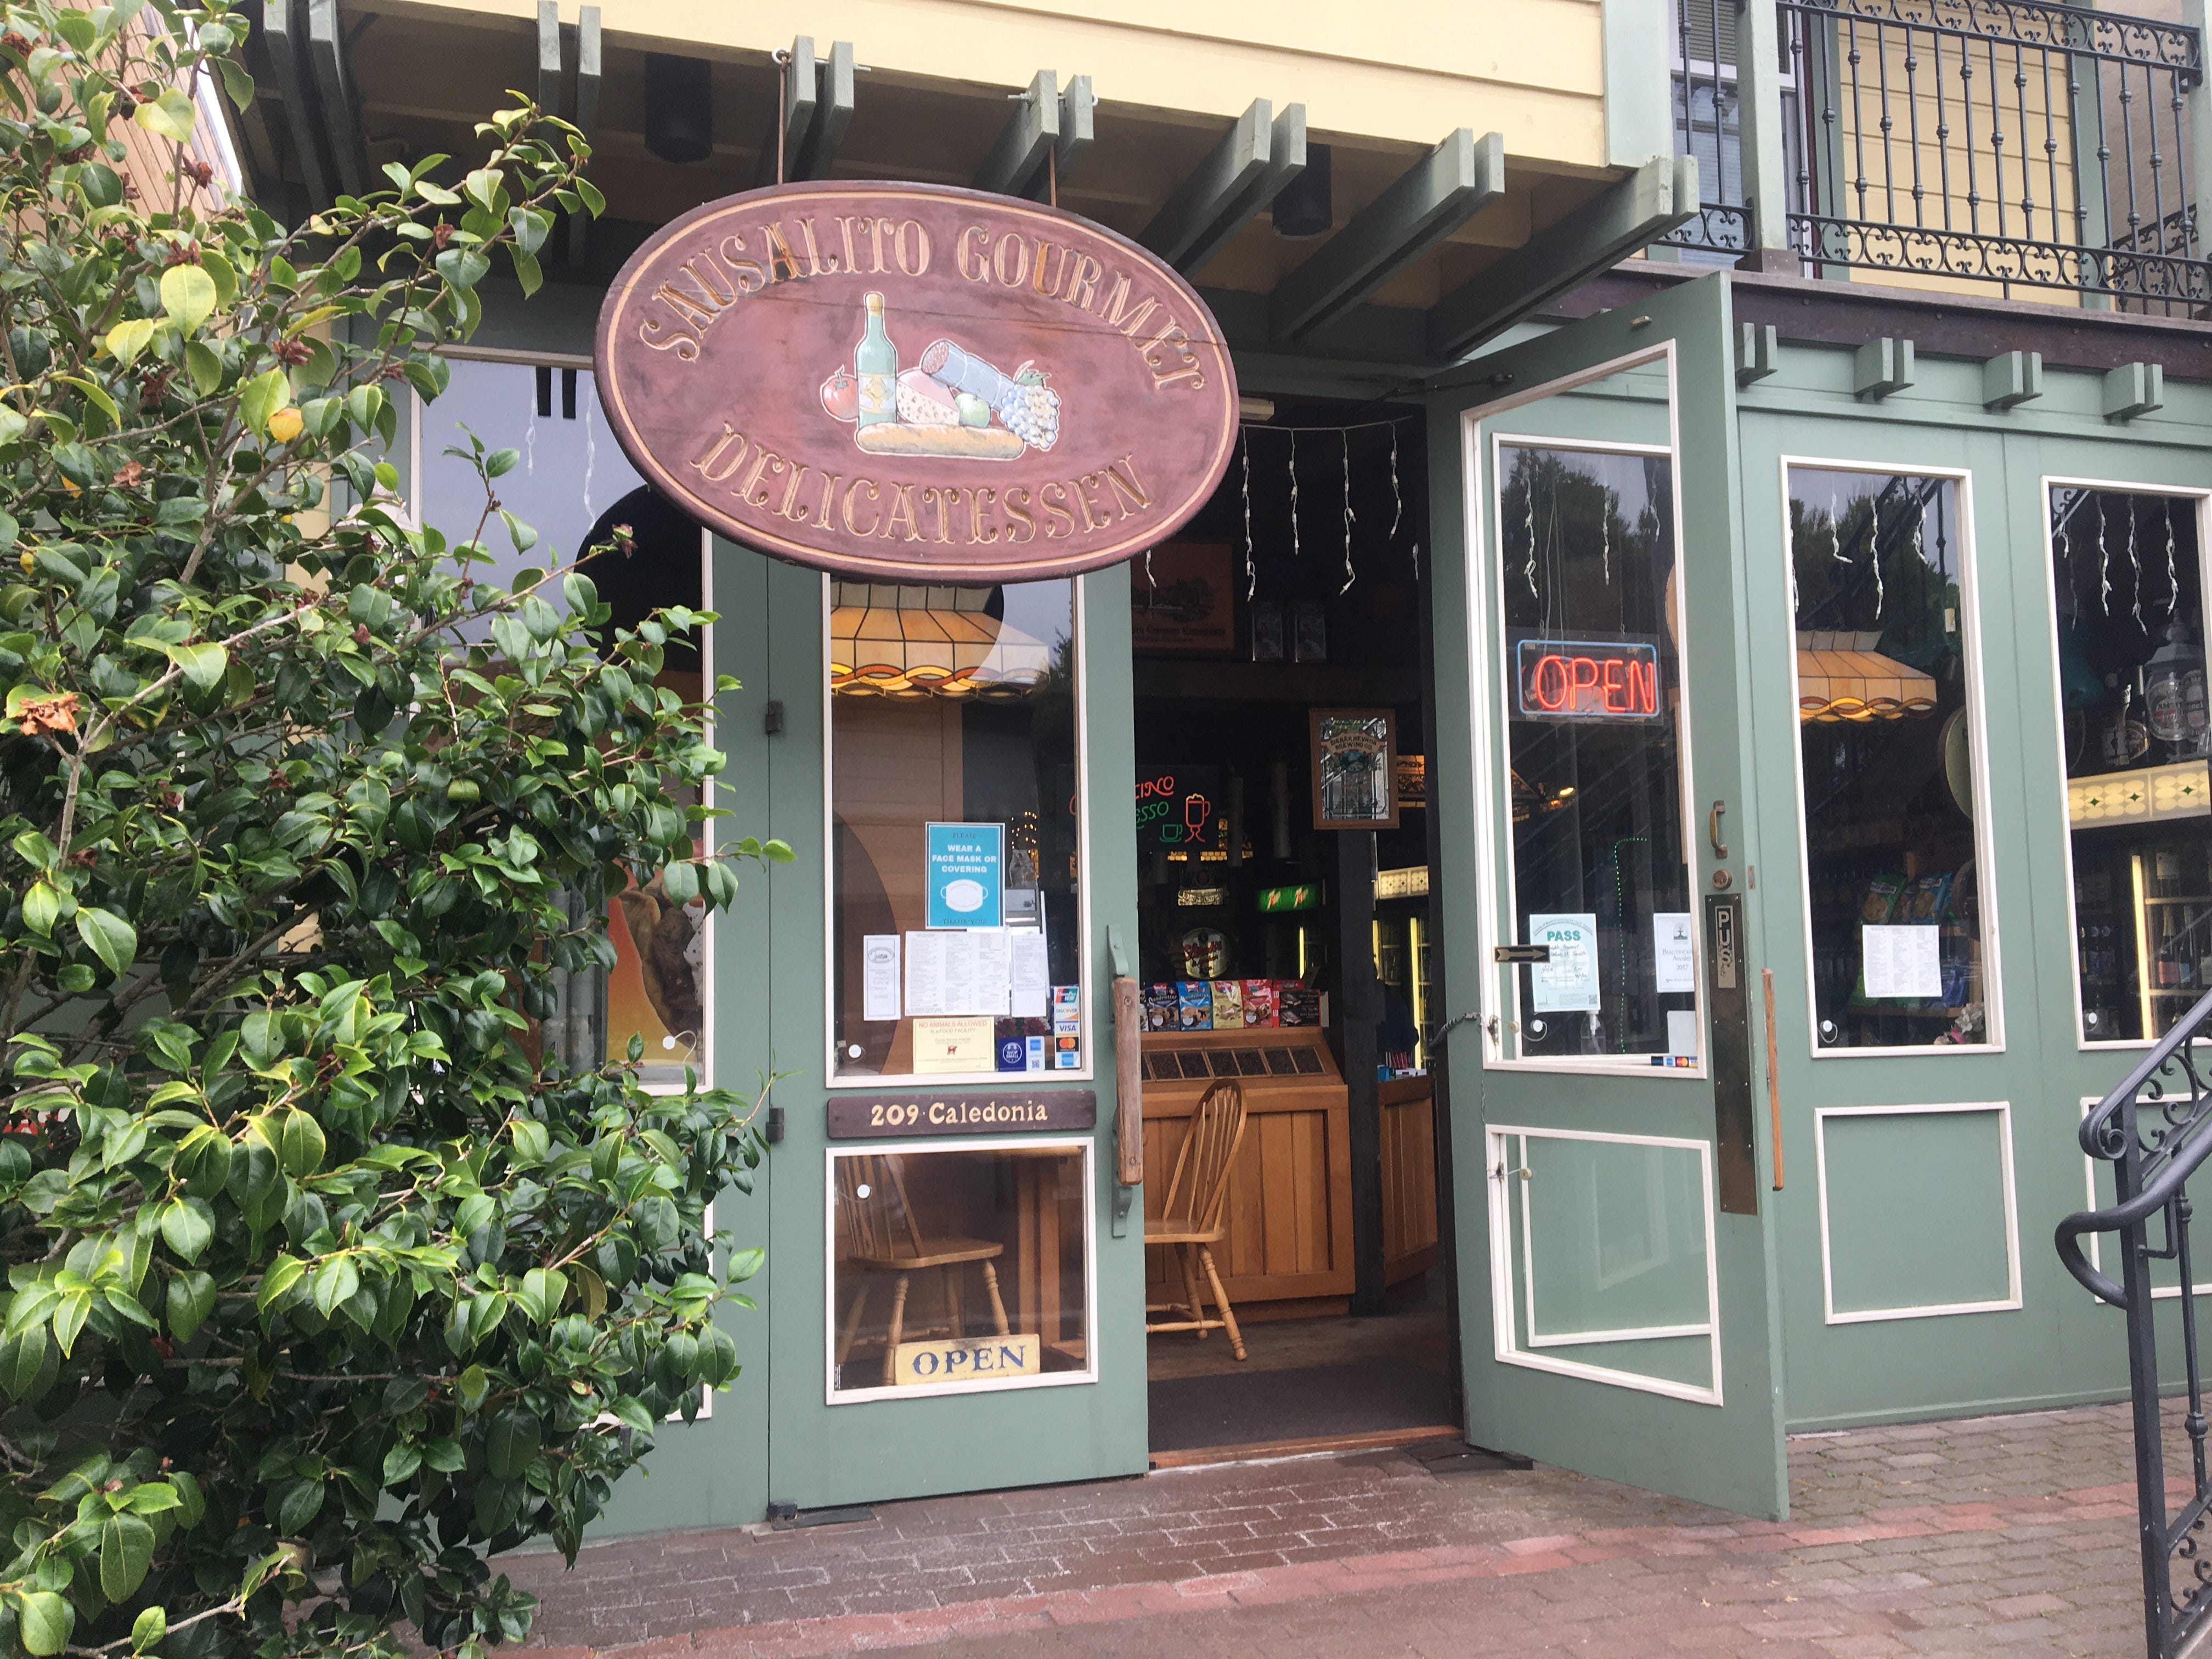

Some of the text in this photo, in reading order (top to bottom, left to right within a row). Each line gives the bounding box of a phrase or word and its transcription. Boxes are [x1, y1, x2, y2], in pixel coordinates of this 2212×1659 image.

[640, 217, 1205, 390] SAUSALITO GOURMET
[690, 422, 1152, 544] DELICATESSEN
[1535, 654, 1655, 713] OPEN
[947, 844, 973, 853] WEAR
[941, 865, 988, 873] COVERING
[1547, 930, 1581, 941] PASS
[871, 1099, 1048, 1127] 209 Caledonia
[912, 1345, 1026, 1376] OPEN
